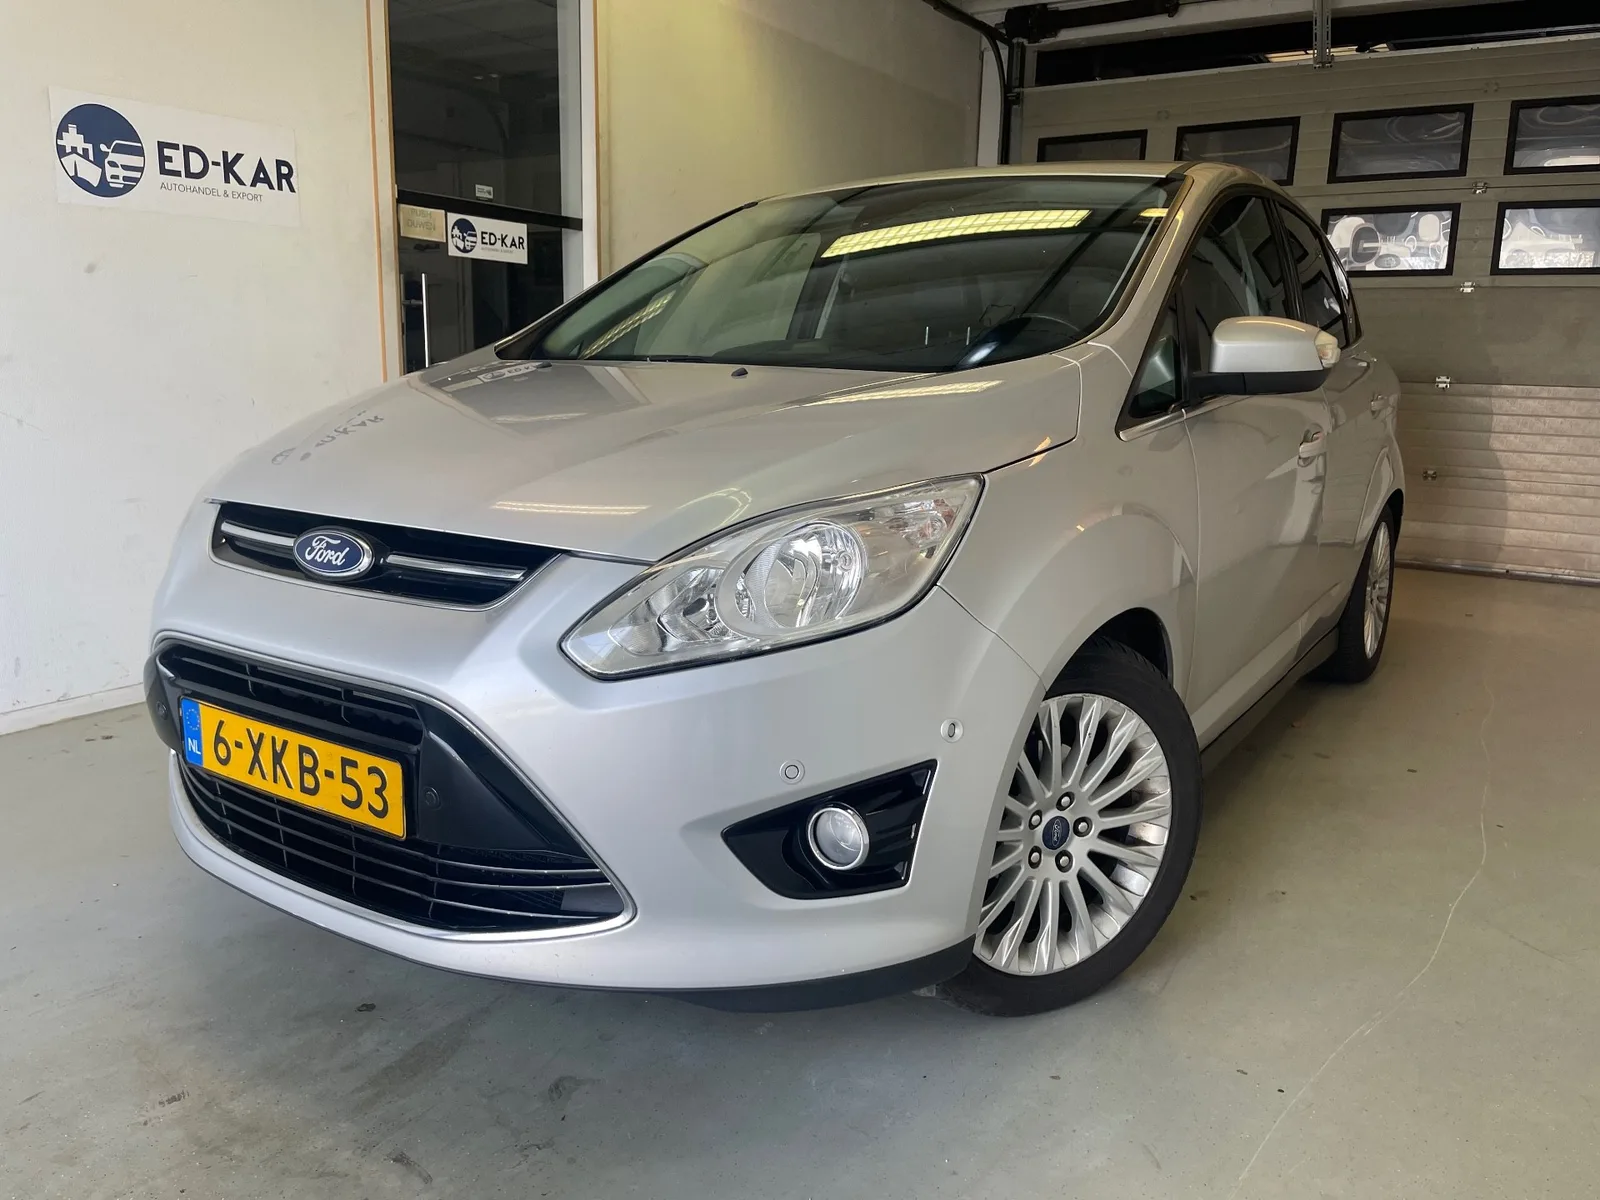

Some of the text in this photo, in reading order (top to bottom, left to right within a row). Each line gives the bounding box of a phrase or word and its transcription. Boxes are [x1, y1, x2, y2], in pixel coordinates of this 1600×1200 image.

[157, 141, 296, 193] ED-KAR
[160, 182, 263, 202] AUTOHANDEL & EXPORT
[481, 231, 525, 250] ED-KAR
[305, 535, 350, 566] Ford
[188, 737, 202, 755] NL
[213, 720, 389, 819] 6-XKB-53
